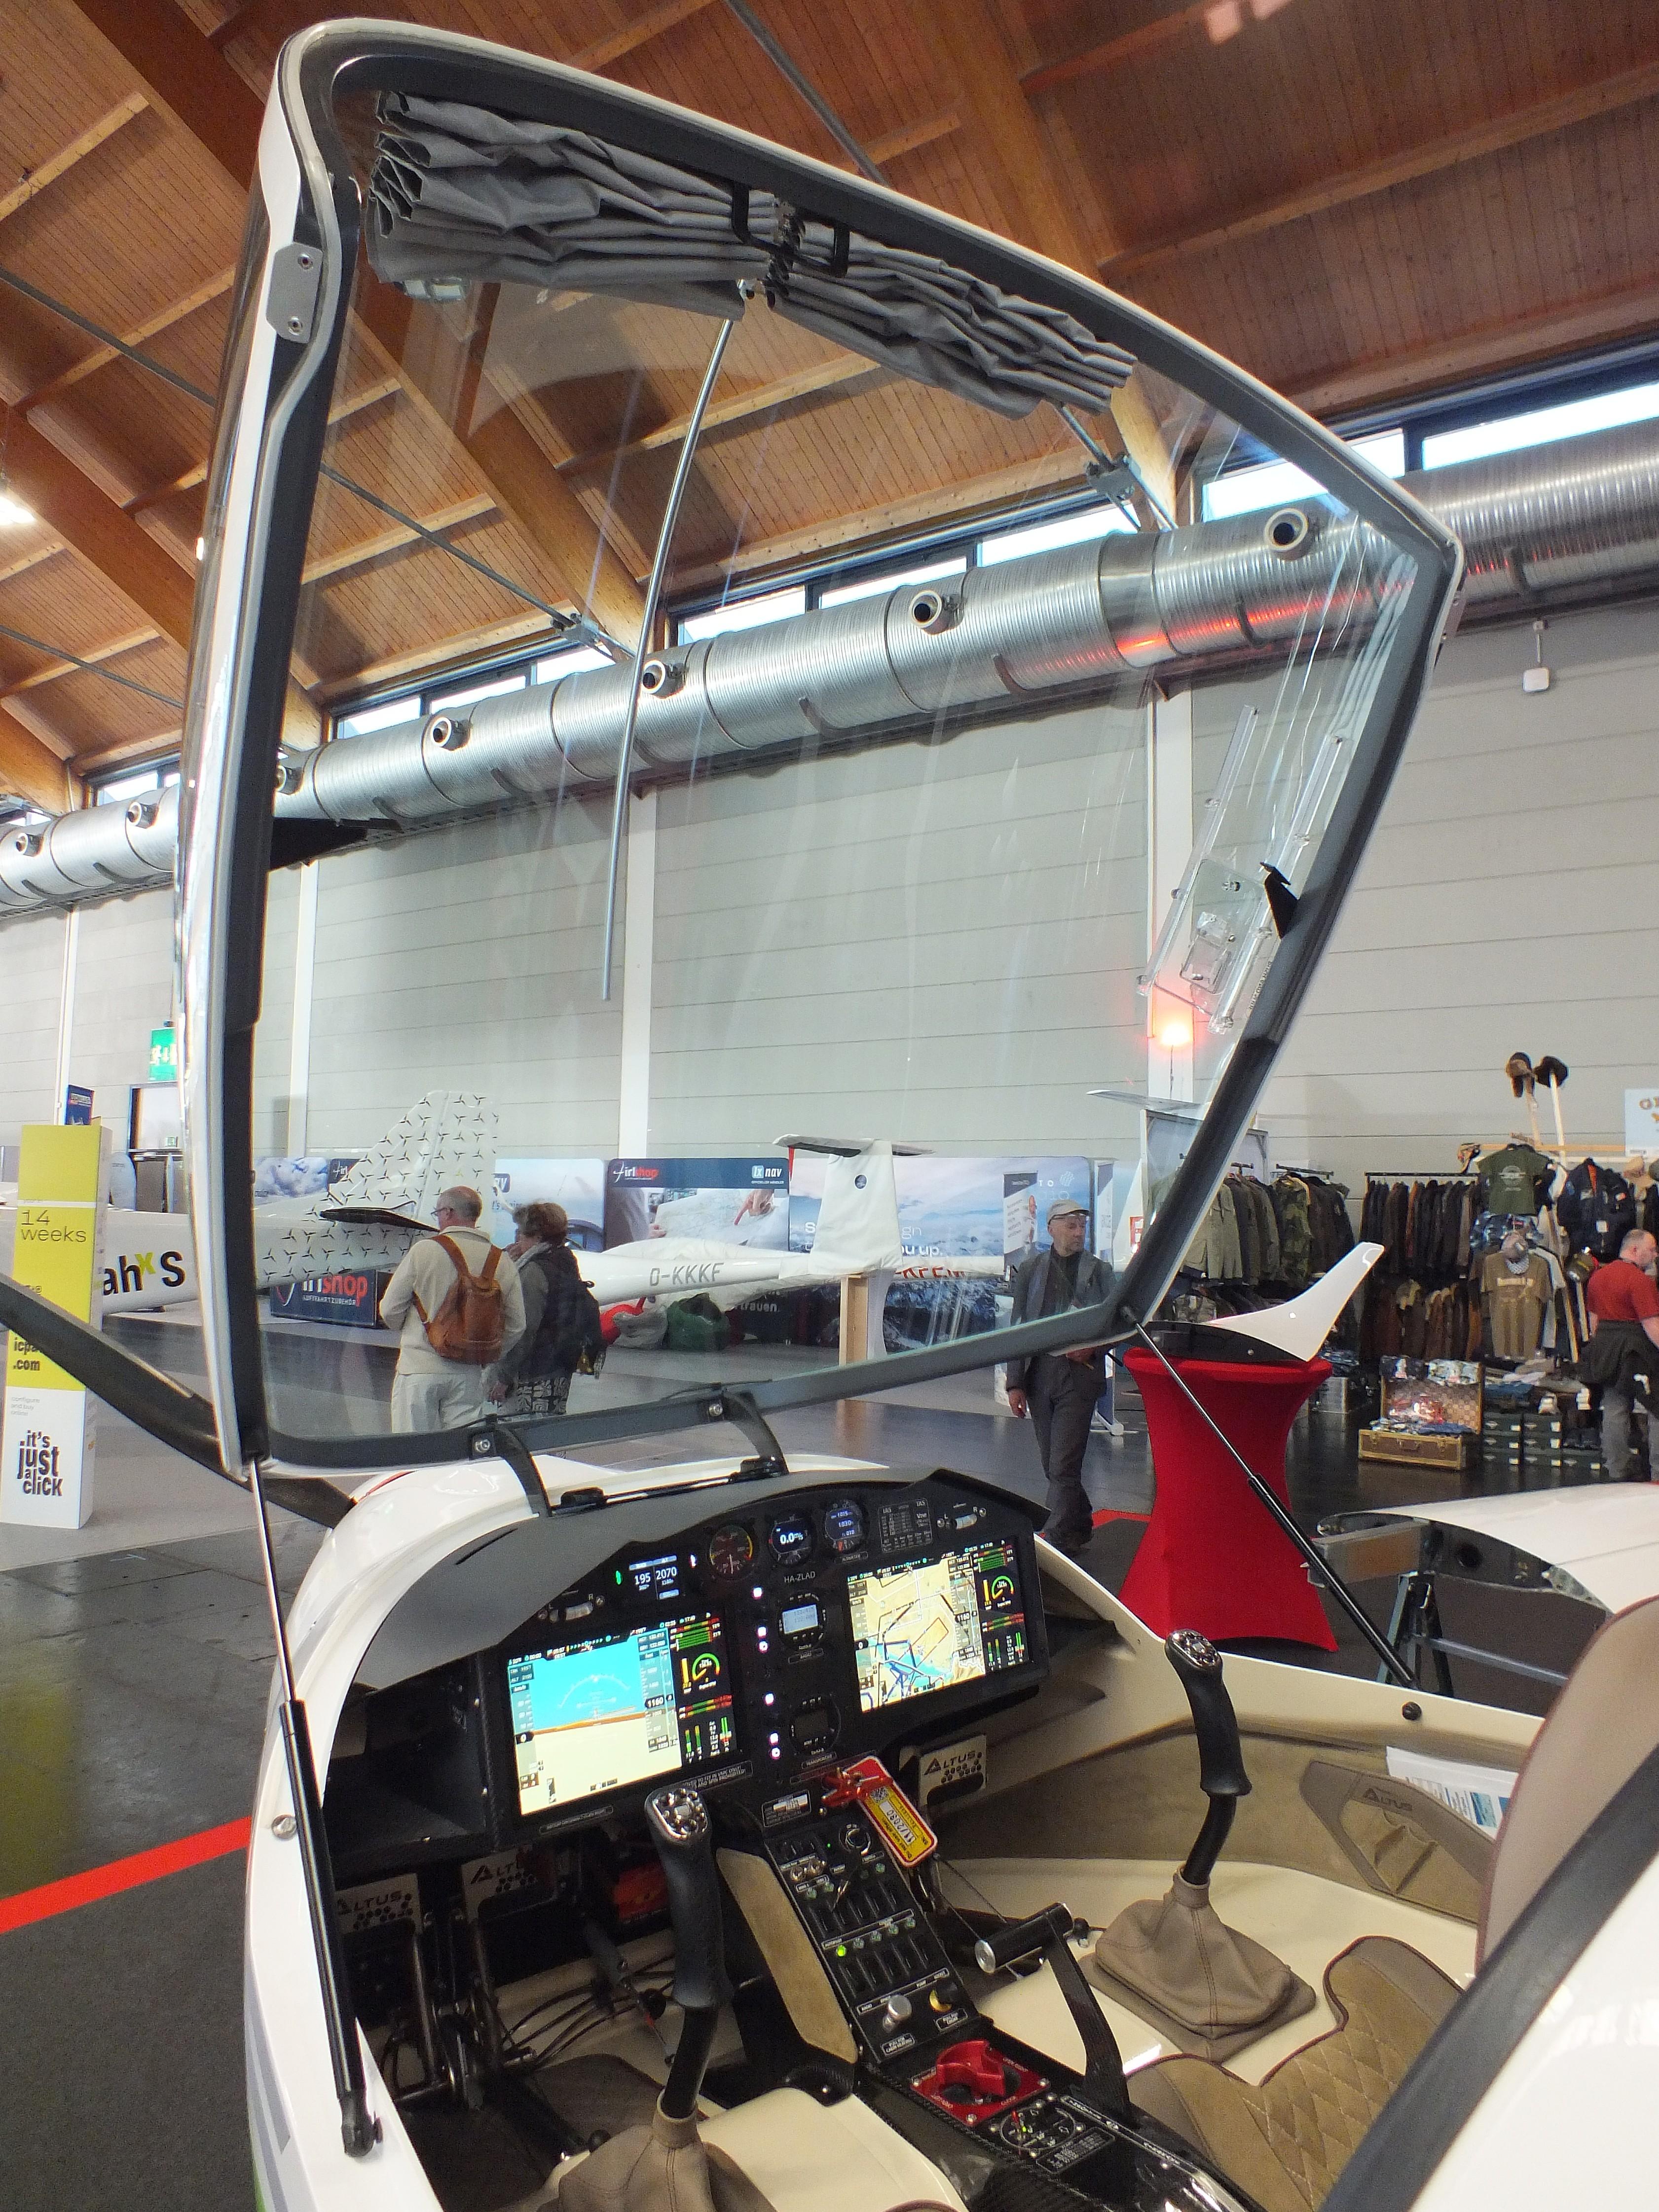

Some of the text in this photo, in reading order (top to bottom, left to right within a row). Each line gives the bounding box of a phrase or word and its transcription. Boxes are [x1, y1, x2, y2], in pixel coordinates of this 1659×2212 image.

[764, 1167, 782, 1177] nav
[21, 1209, 50, 1226] 14
[21, 1226, 87, 1242] weeks
[649, 1262, 724, 1287] D-KKKF
[13, 1359, 40, 1371] .com
[17, 1440, 60, 1480] just
[779, 1532, 795, 1545] 0.0
[634, 1572, 651, 1585] 195
[655, 1566, 677, 1580] 2070
[647, 1697, 664, 1707] 1160
[922, 1750, 976, 1776] ALTUS
